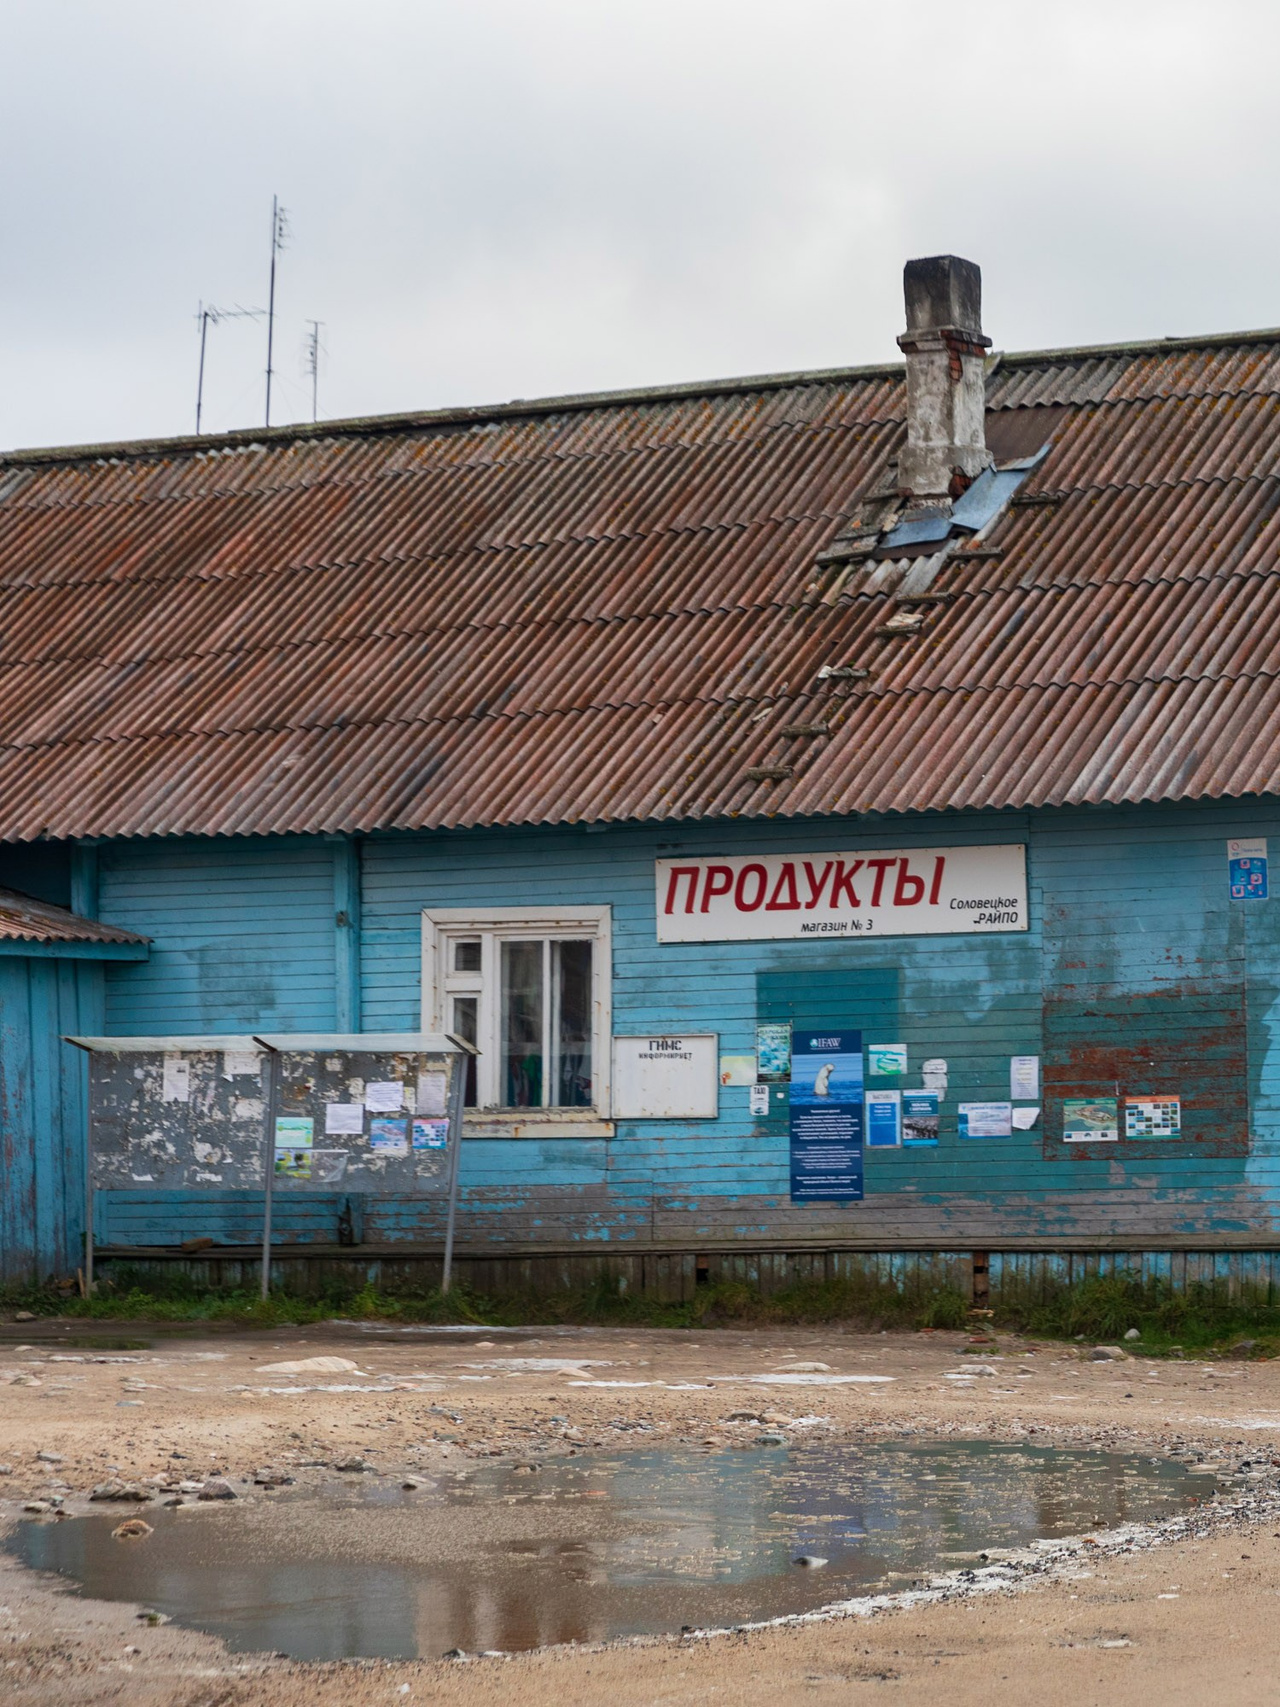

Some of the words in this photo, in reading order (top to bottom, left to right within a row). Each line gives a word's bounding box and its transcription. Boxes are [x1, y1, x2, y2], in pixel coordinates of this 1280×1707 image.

[664, 856, 945, 914] ПРОДУКТЫ
[949, 897, 1018, 910] Соловецкое
[978, 910, 1018, 924] РАЙПО
[801, 922, 848, 932] магазин
[866, 919, 873, 931] 3
[817, 1037, 842, 1048] IFAW
